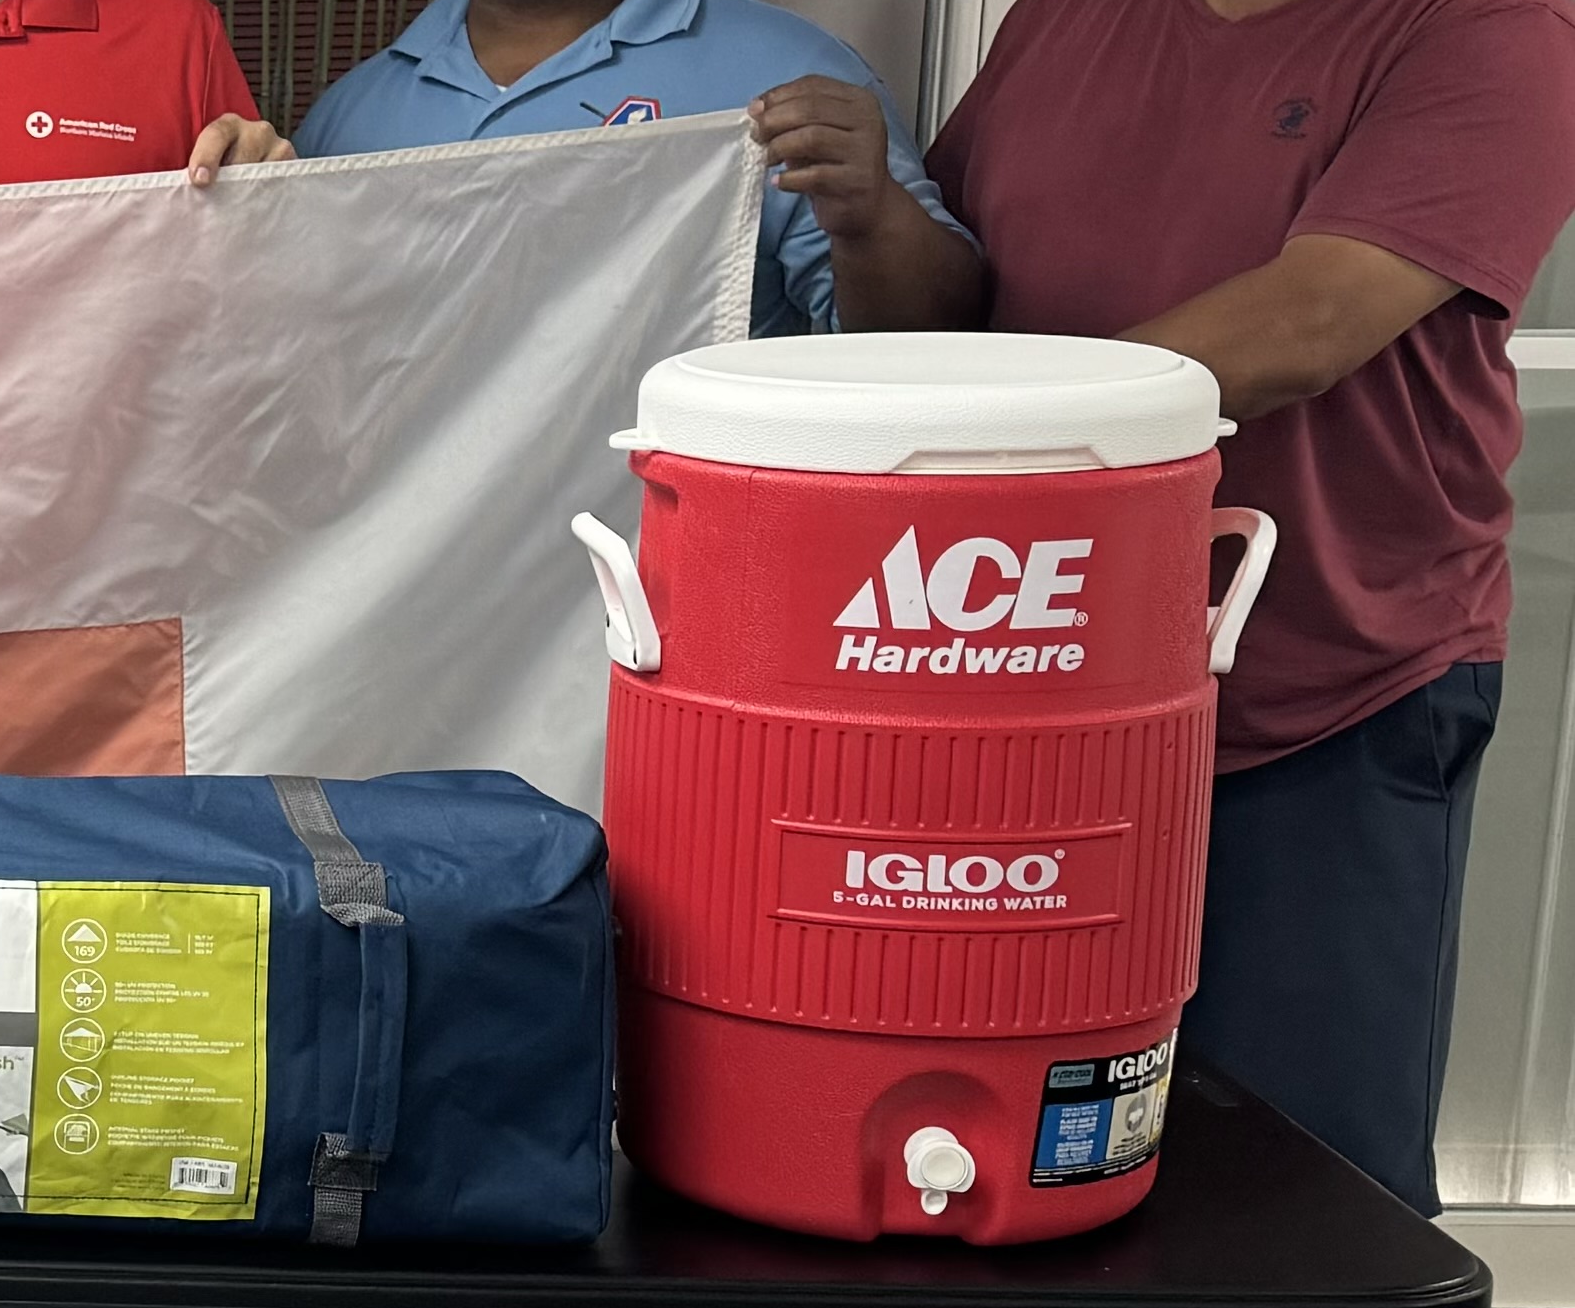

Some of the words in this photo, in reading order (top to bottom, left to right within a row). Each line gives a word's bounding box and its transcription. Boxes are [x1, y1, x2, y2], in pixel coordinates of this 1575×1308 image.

[835, 634, 1085, 675] Hardware
[833, 891, 896, 908] 5-GAL
[903, 896, 998, 911] DRINKING
[1003, 895, 1067, 910] WATER
[74, 945, 96, 958] 169
